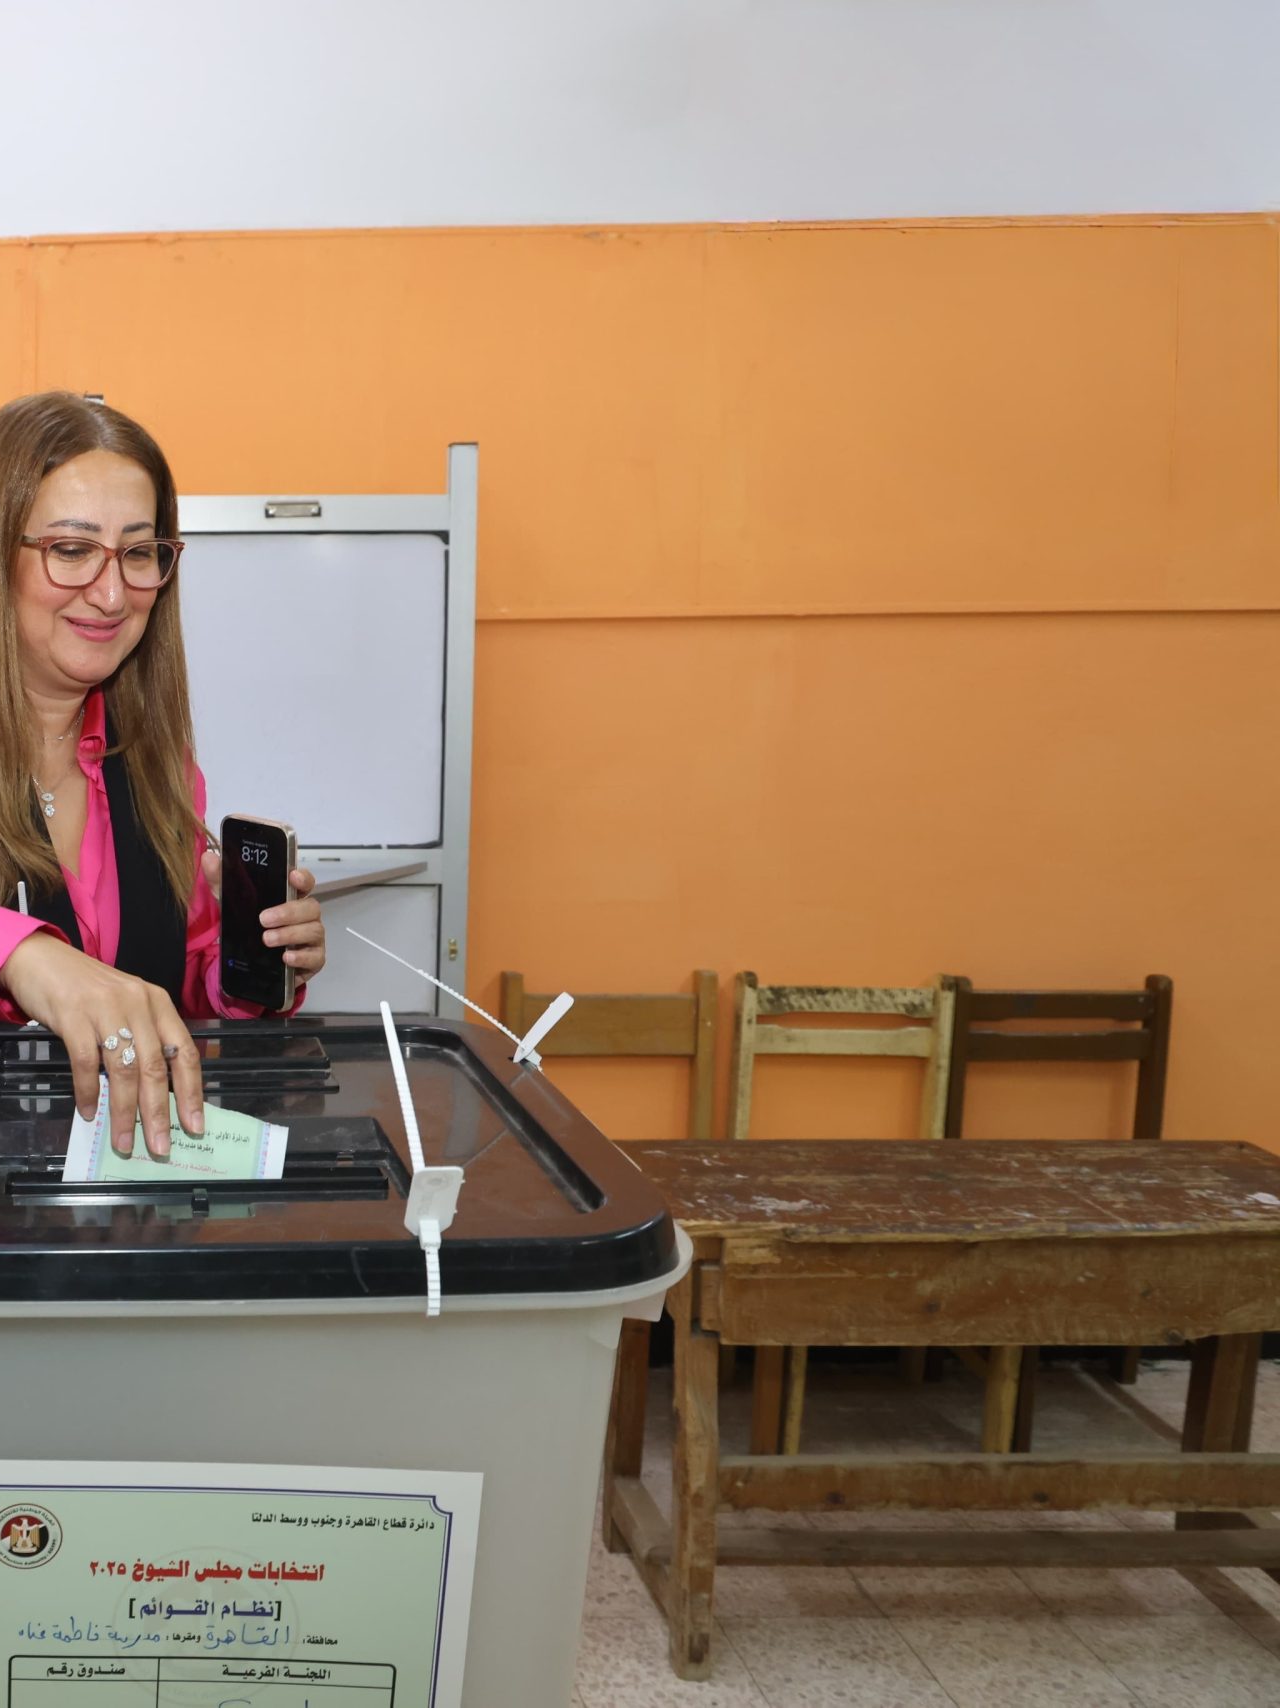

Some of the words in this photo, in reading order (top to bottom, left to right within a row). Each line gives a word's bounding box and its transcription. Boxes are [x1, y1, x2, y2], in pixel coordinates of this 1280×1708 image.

[241, 846, 268, 867] 8:12
[251, 1512, 277, 1523] الدلتا
[280, 1513, 308, 1527] ووسط
[311, 1514, 343, 1528] وجنوب
[345, 1514, 380, 1529] القاهرة
[382, 1516, 407, 1531] قطاع
[409, 1517, 435, 1532] دائرة
[89, 1561, 127, 1577] ٢٠٢٥
[131, 1558, 190, 1583] الشيوخ
[194, 1560, 243, 1584] مجلس
[248, 1561, 325, 1586] انتخابات
[203, 1623, 290, 1650] القاهرة
[46, 1662, 74, 1679] رقم
[77, 1663, 126, 1678] صندوق
[221, 1664, 280, 1680] الفرعية
[283, 1665, 331, 1682] اللجنة
